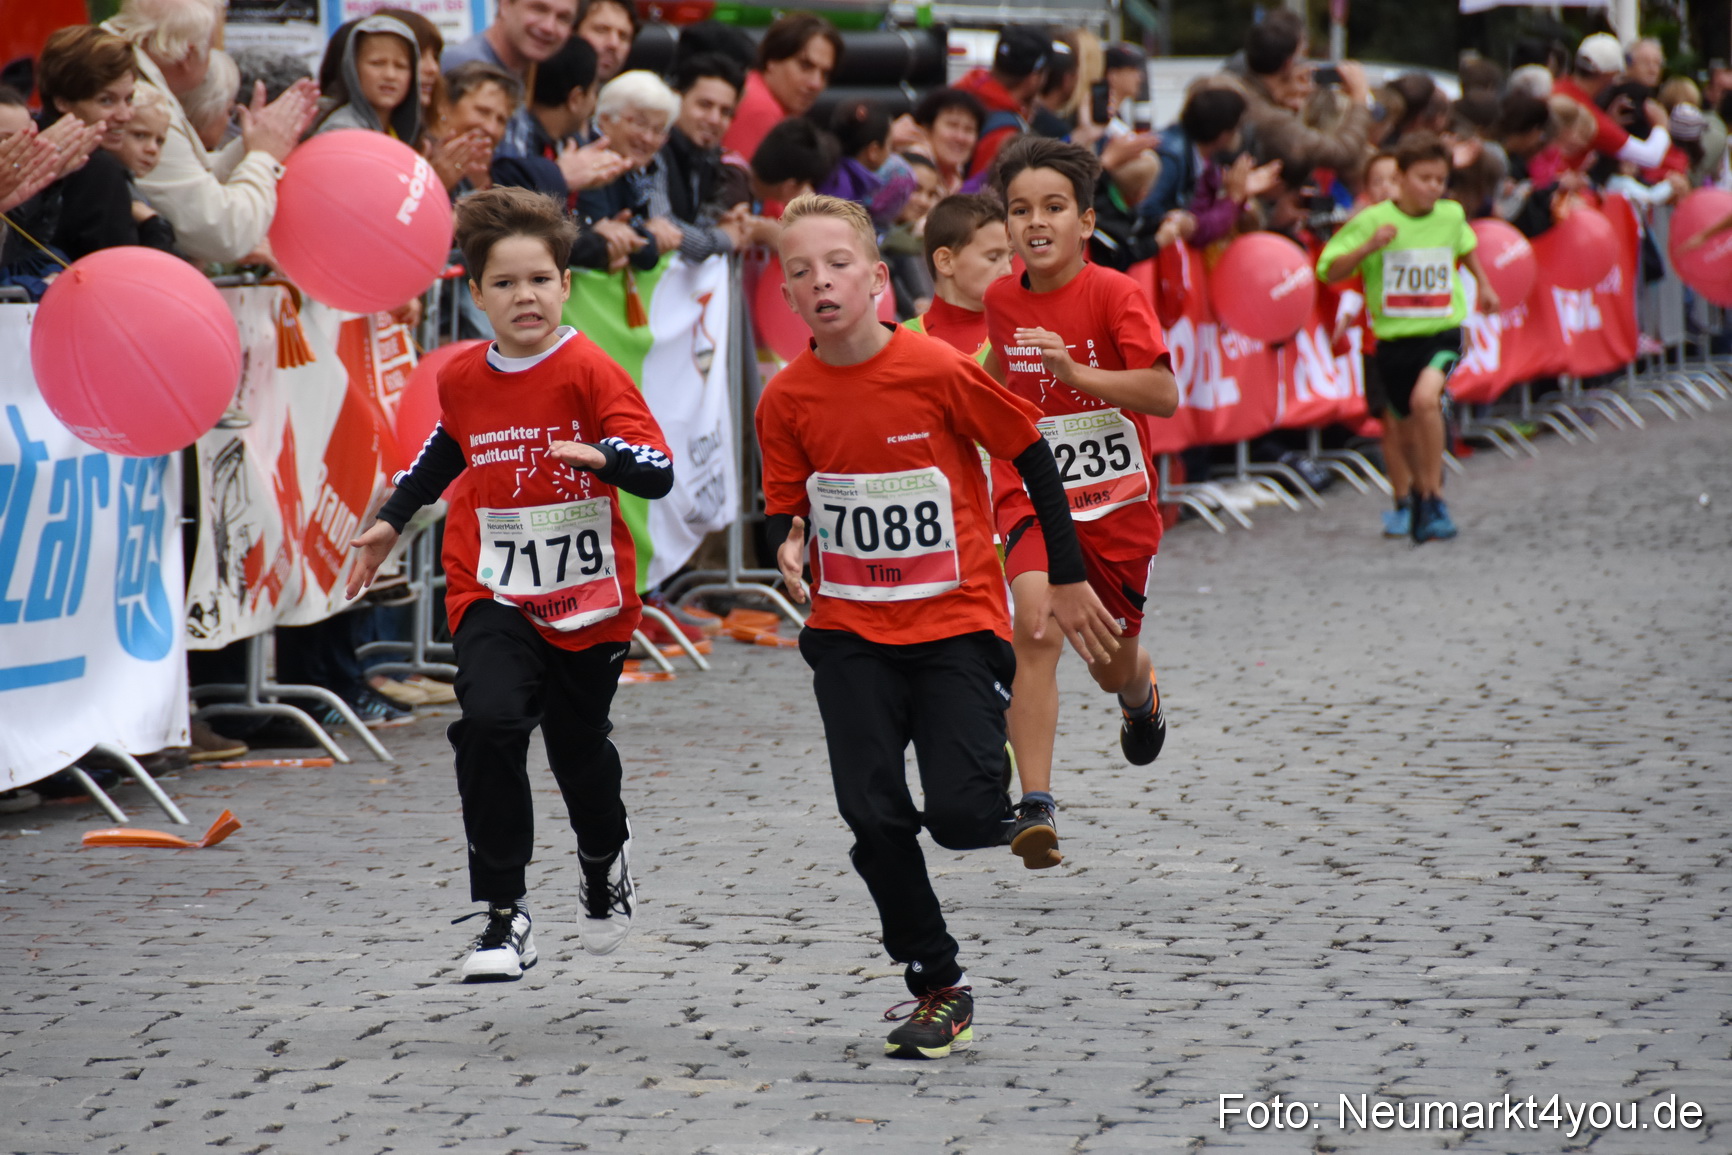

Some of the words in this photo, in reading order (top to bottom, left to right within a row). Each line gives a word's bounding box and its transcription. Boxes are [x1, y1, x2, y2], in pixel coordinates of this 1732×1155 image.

[1391, 265, 1448, 290] 7009
[1063, 412, 1123, 432] BOCK
[469, 426, 541, 448] Neumarkter
[887, 436, 897, 444] FC
[1054, 432, 1131, 482] 235
[817, 486, 859, 496] NeuerMarkt
[866, 473, 937, 494] BOCK
[0, 405, 110, 624] tar
[530, 503, 598, 526] BOCK
[823, 500, 942, 552] 7088
[945, 540, 951, 548] K
[493, 529, 603, 587] 7179
[605, 566, 612, 575] K
[866, 564, 902, 582] Tim
[523, 596, 578, 619] Quirin
